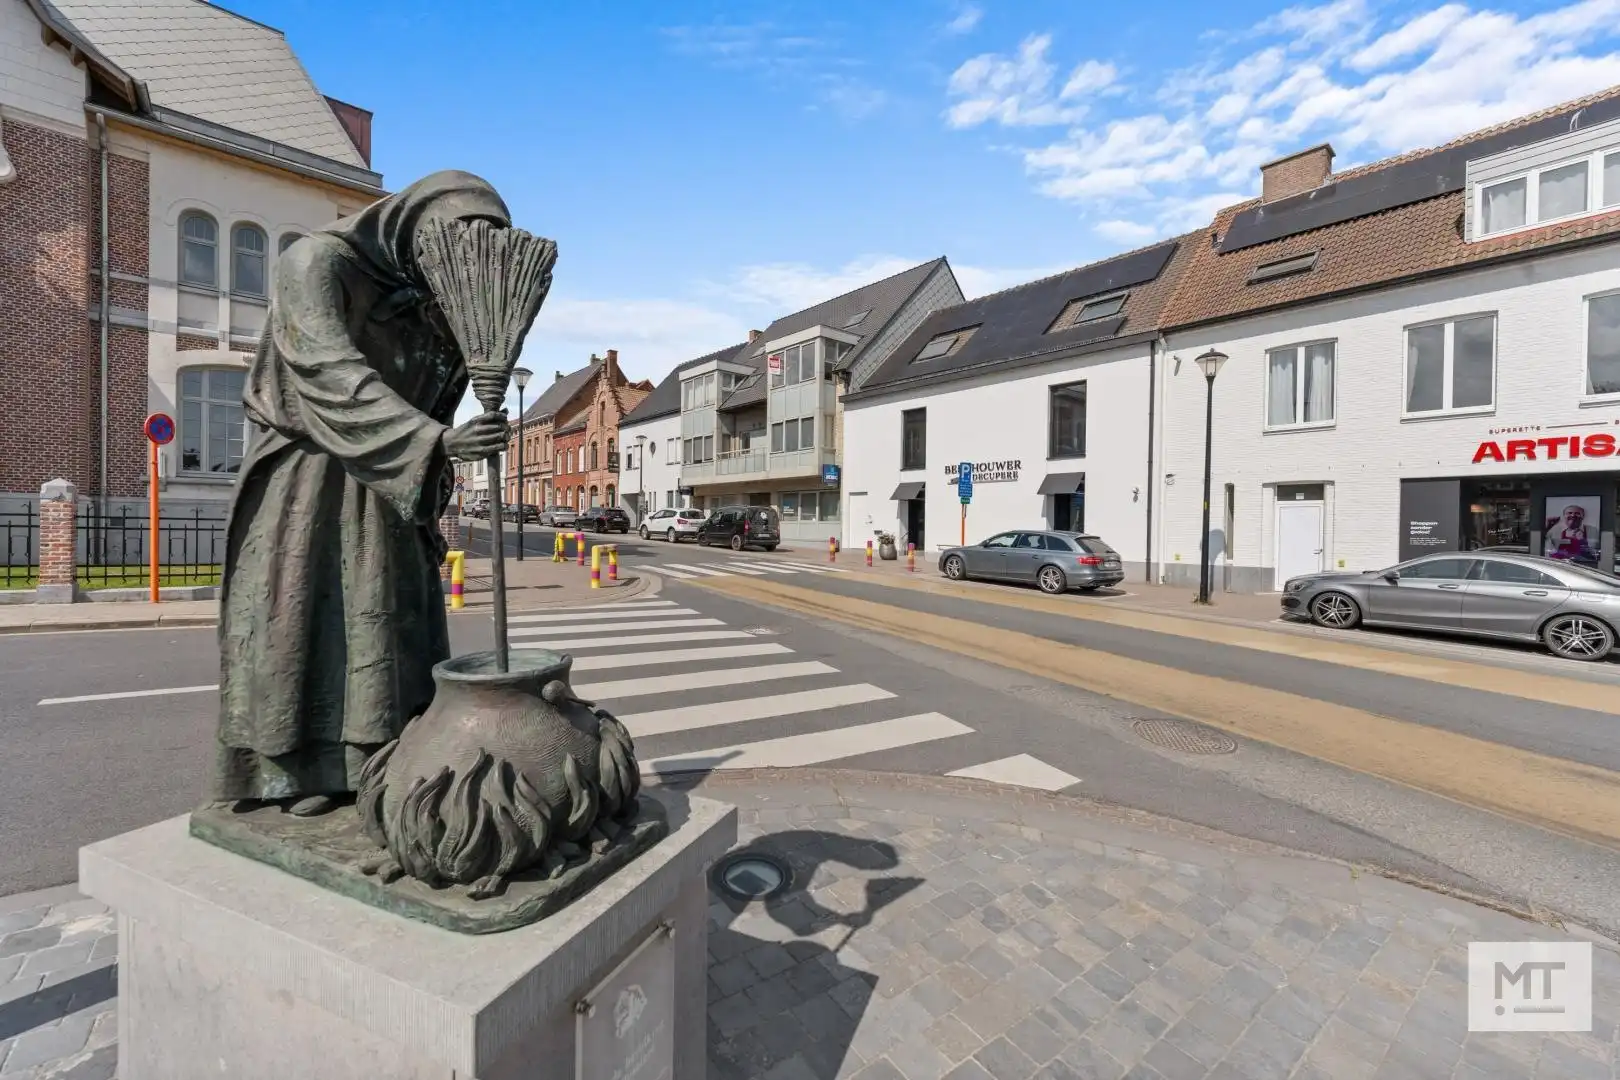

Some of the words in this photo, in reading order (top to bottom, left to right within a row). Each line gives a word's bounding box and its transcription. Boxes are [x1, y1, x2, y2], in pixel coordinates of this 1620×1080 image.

[1489, 425, 1541, 435] SUPERETTE
[1472, 433, 1620, 464] ARTIS
[944, 460, 1021, 475] BEHOUWER
[961, 463, 970, 479] P
